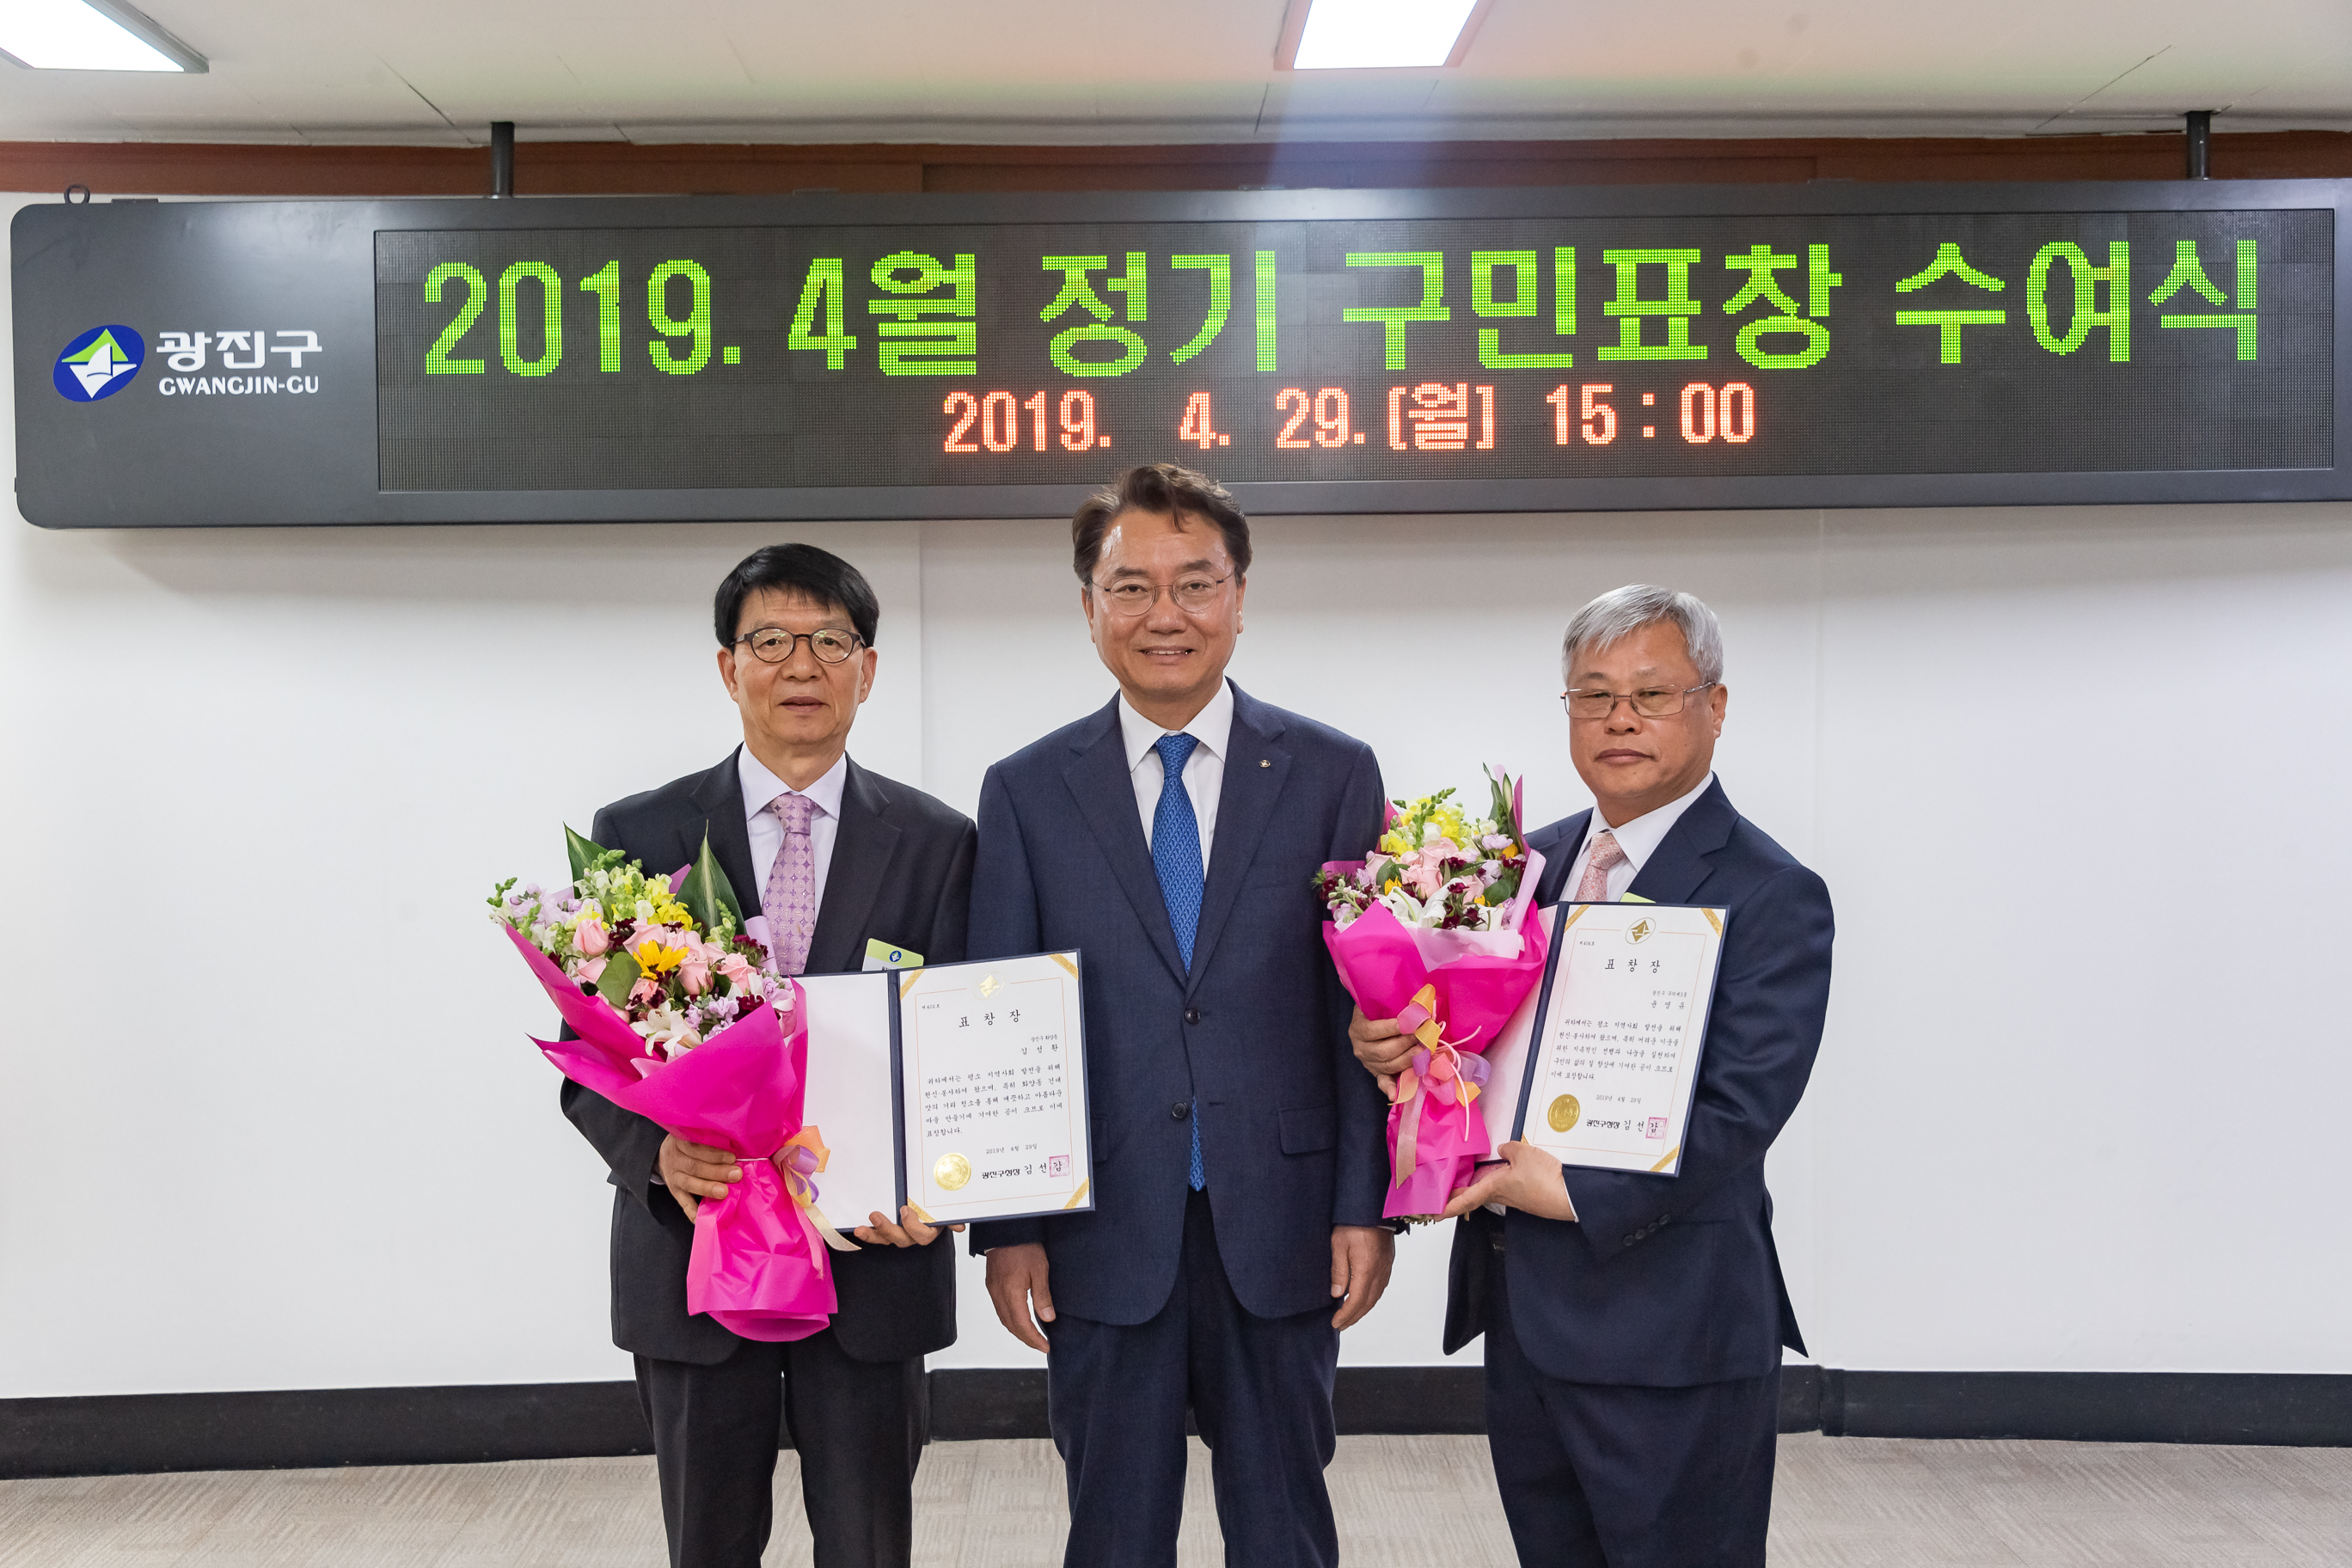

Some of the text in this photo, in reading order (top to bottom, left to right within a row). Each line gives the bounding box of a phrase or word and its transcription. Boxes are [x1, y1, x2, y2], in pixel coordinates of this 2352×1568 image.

[425, 240, 2257, 377] 2019. 4월 정기 구민표창 수여식
[156, 330, 323, 371] 광진구
[159, 376, 318, 395] GWANGJIN-GU
[943, 390, 1112, 452] 2019.
[1178, 391, 1230, 452] 4.
[1605, 959, 1661, 973] 표 창 장
[959, 1009, 1021, 1027] 표 창 장
[928, 1075, 962, 1085] 귀하께서는
[989, 1069, 1014, 1077] 지역사회
[1021, 1066, 1041, 1075] 발전을
[1049, 1076, 1062, 1085] 건대
[961, 1099, 981, 1107] 청소를
[1004, 1093, 1031, 1102] 깨끗하고
[1035, 1089, 1063, 1098] 아름다운
[946, 1112, 972, 1122] 만들기에
[1005, 1107, 1018, 1116] 공이
[927, 1127, 963, 1136] 표창합니다.
[1587, 1119, 1620, 1129] 광진구청장
[1625, 1119, 1632, 1130] 김
[1637, 1121, 1645, 1131] 선
[982, 1169, 1020, 1179] 광진구청장
[1025, 1164, 1032, 1174] 김
[1039, 1162, 1047, 1173] 선
